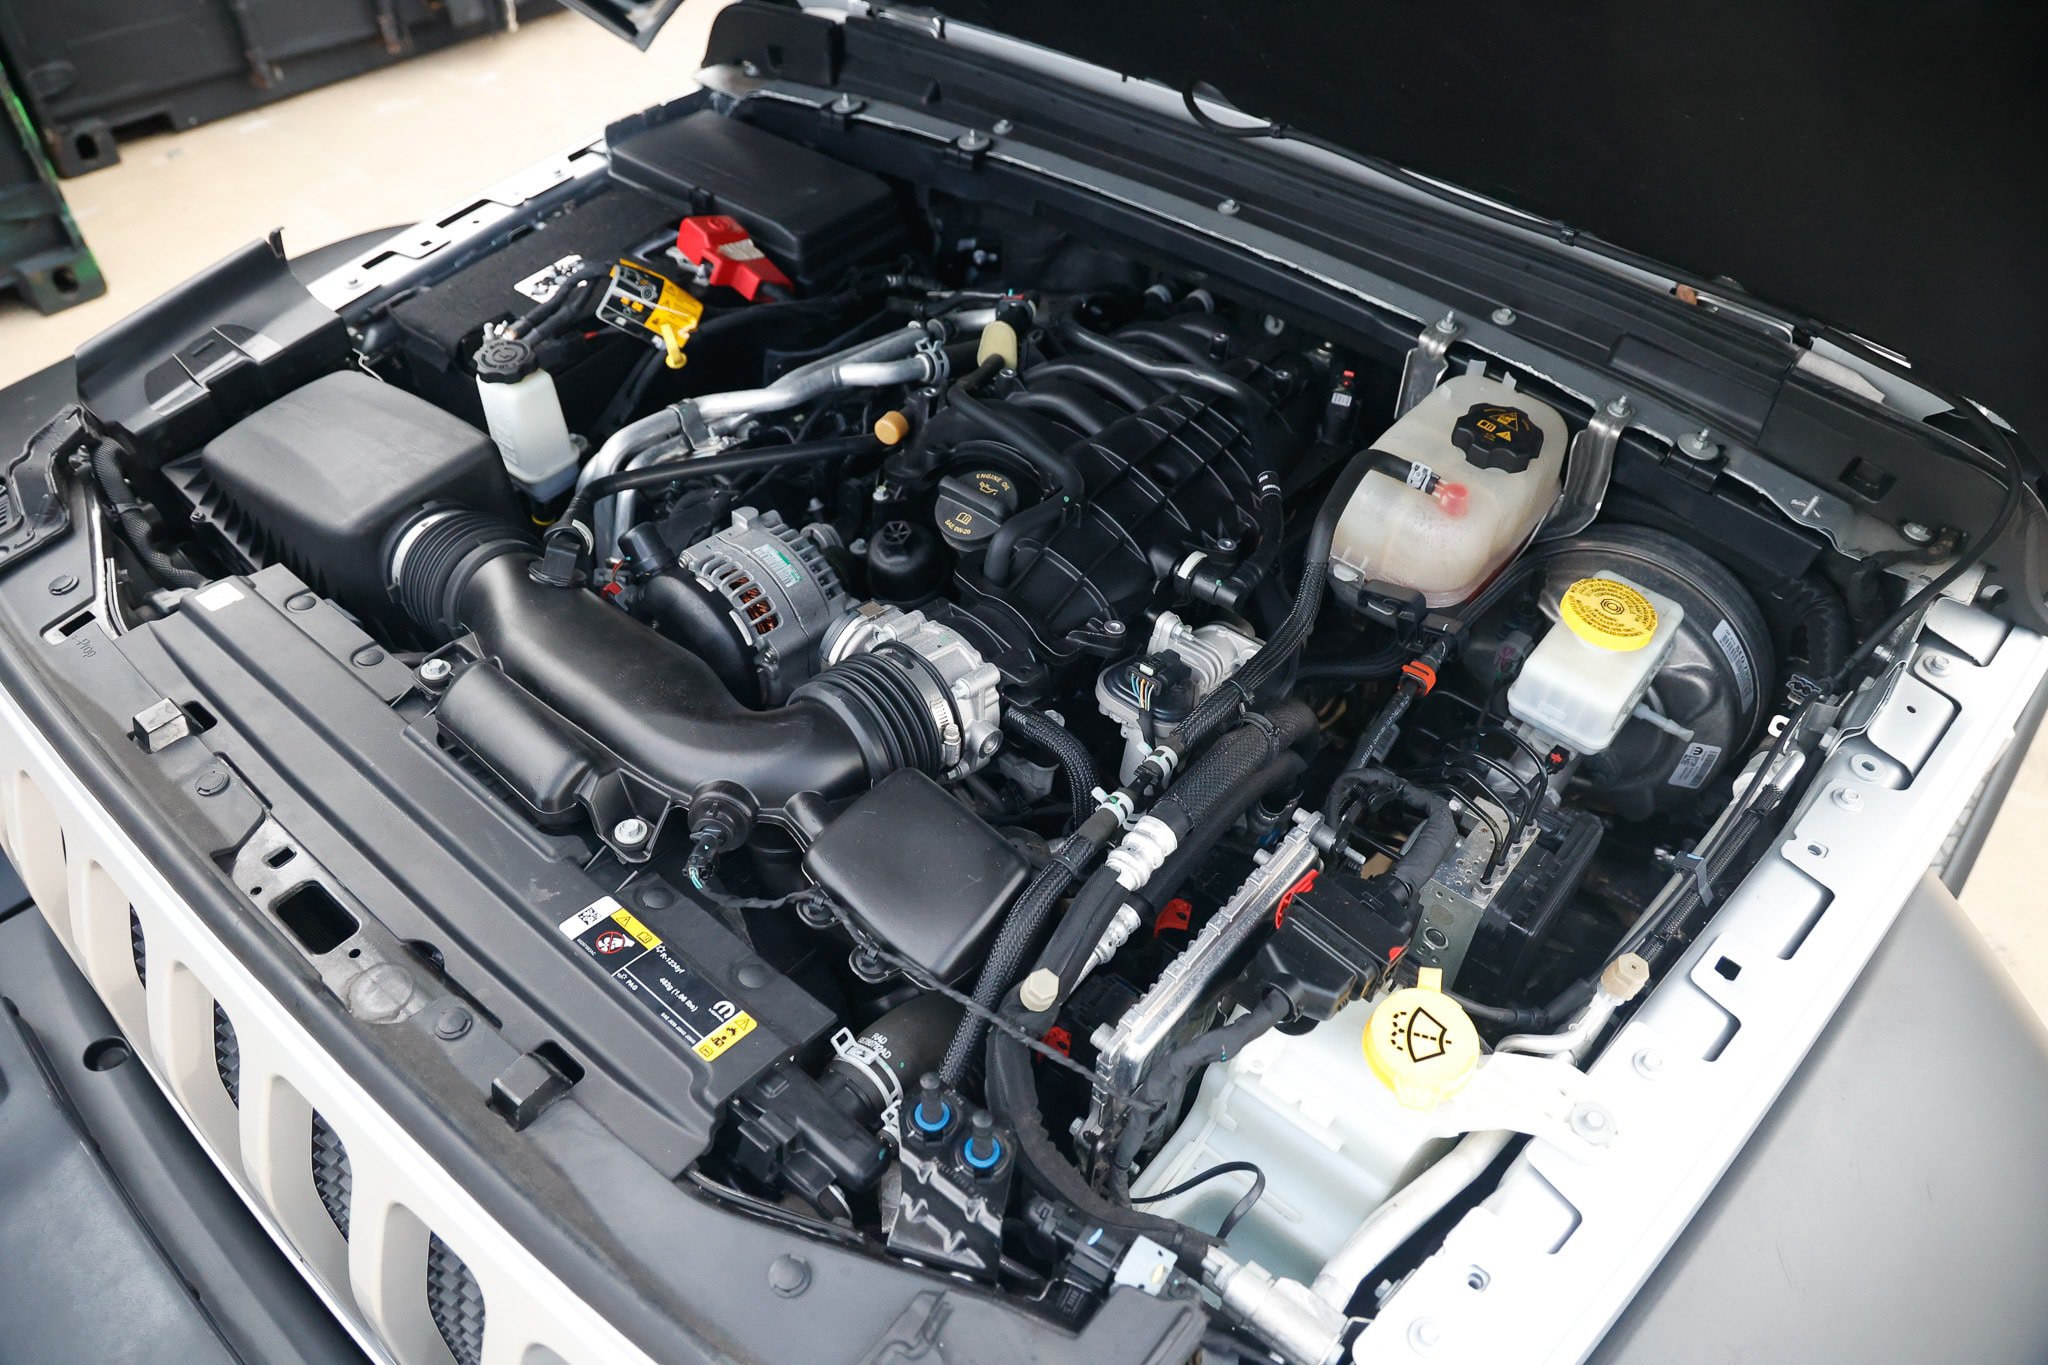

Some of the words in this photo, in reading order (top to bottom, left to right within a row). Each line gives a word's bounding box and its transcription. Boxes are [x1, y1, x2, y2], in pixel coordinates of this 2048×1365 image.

[976, 473, 1002, 483] ENGINE
[1001, 481, 1010, 491] OIL
[944, 519, 955, 530] SAE
[954, 527, 971, 535] 0W-20
[660, 952, 685, 974] R-1234yf
[871, 1032, 888, 1045] RAD
